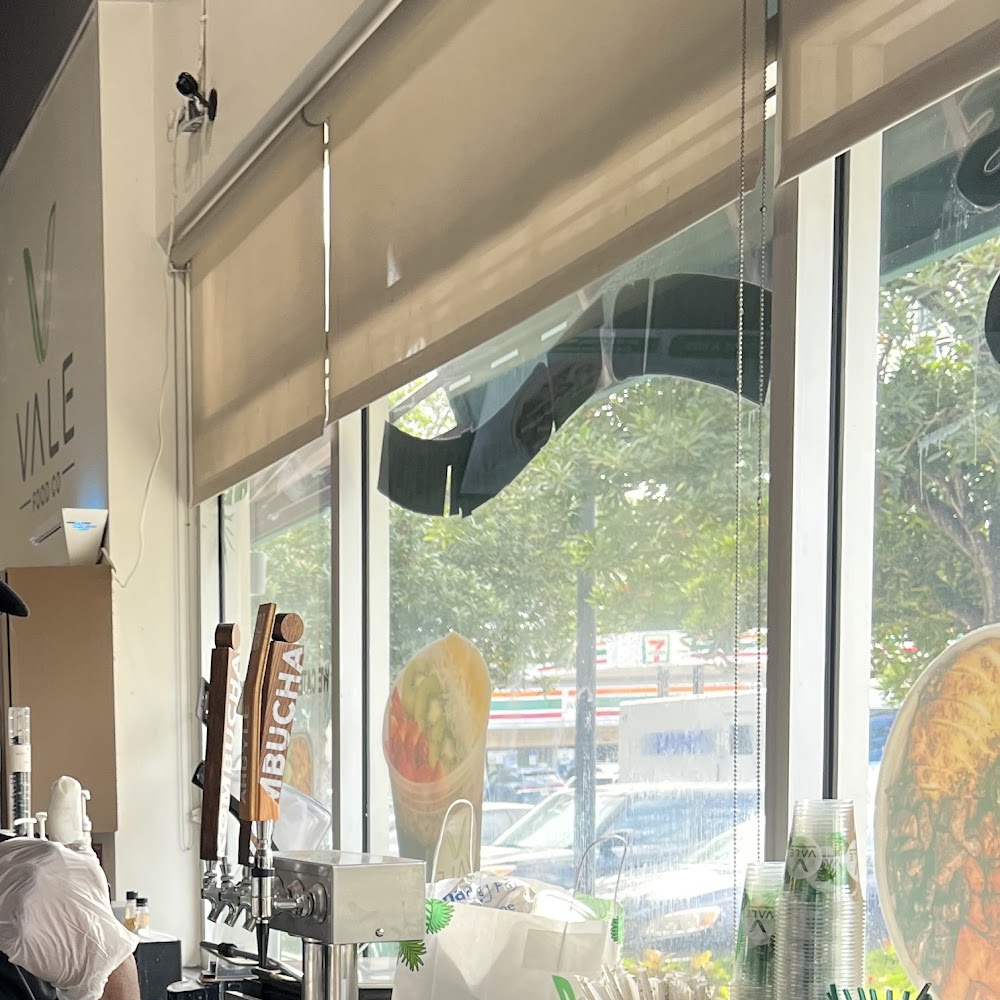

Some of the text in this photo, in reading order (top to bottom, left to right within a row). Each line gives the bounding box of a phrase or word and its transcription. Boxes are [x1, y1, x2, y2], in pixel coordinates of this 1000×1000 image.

[16, 352, 75, 484] VALE
[32, 470, 62, 512] FOOD CO
